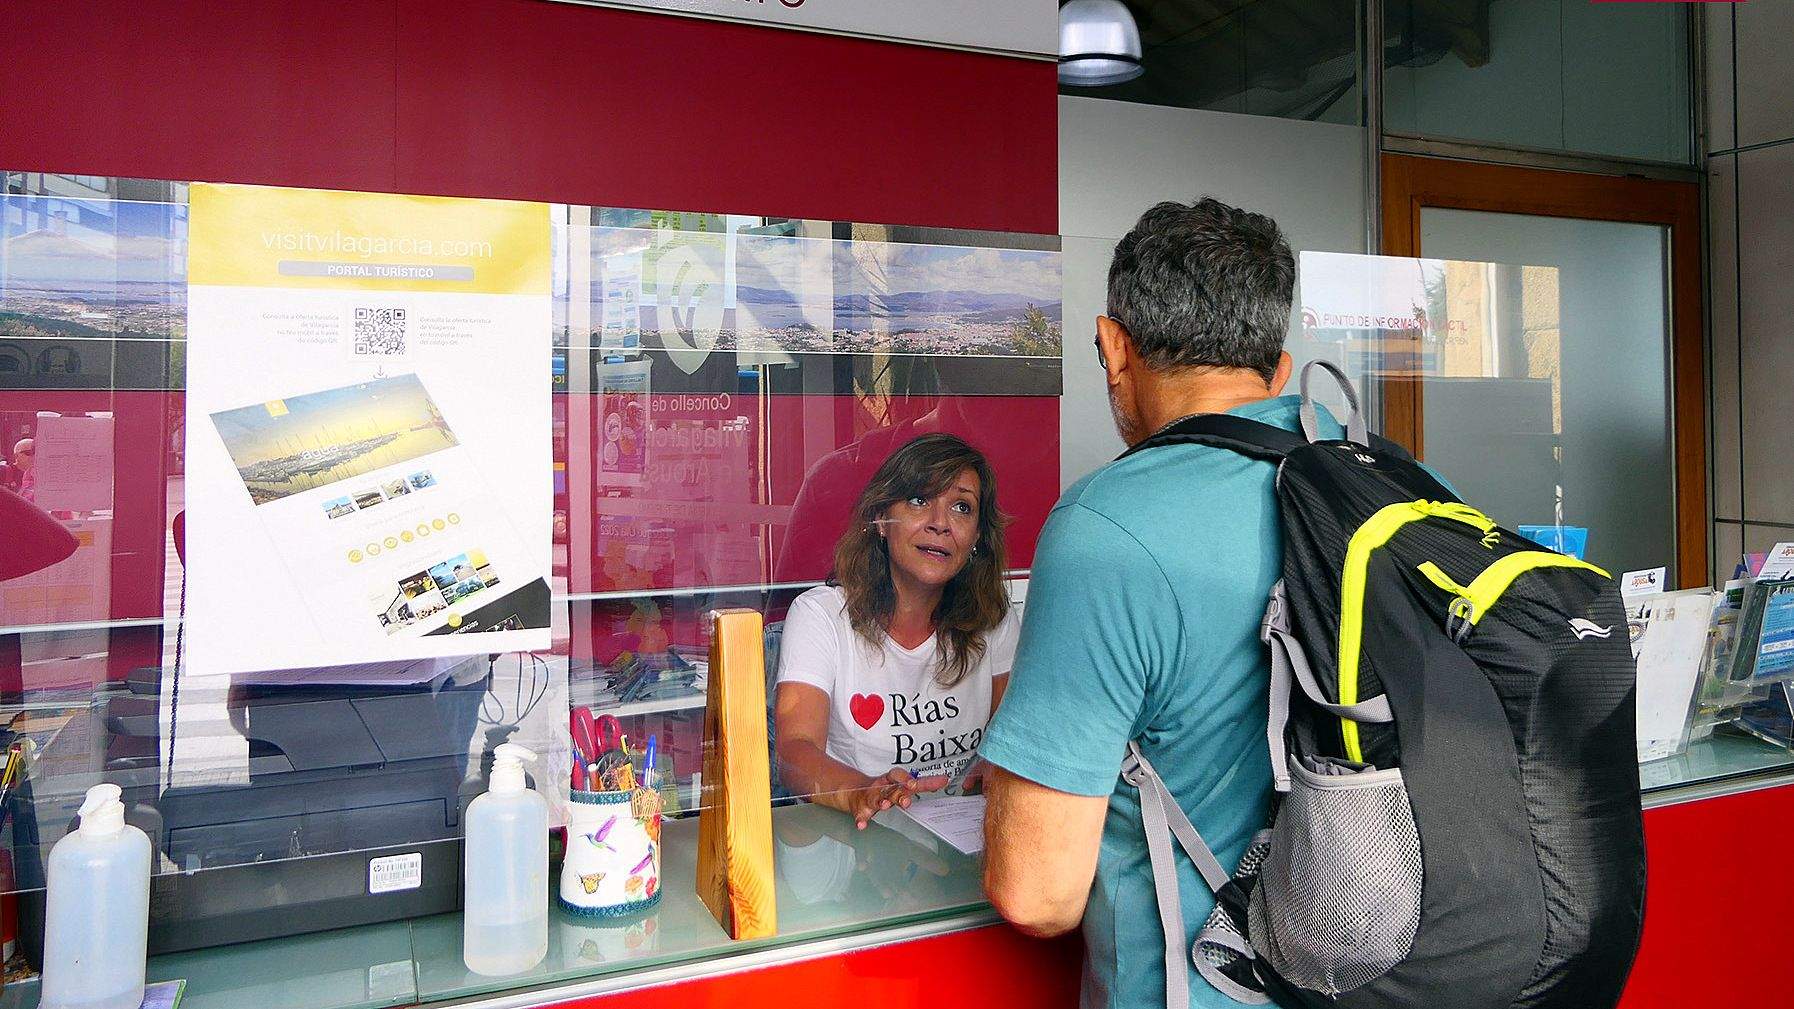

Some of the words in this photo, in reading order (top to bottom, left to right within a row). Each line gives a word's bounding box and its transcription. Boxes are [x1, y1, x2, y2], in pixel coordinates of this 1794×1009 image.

[327, 264, 372, 277] PORTAL
[374, 264, 434, 278] TURÍSTICO
[1323, 313, 1355, 326] PUNTO
[1358, 315, 1370, 328] DE
[888, 692, 960, 727] Rías
[891, 728, 985, 765] Baixa
